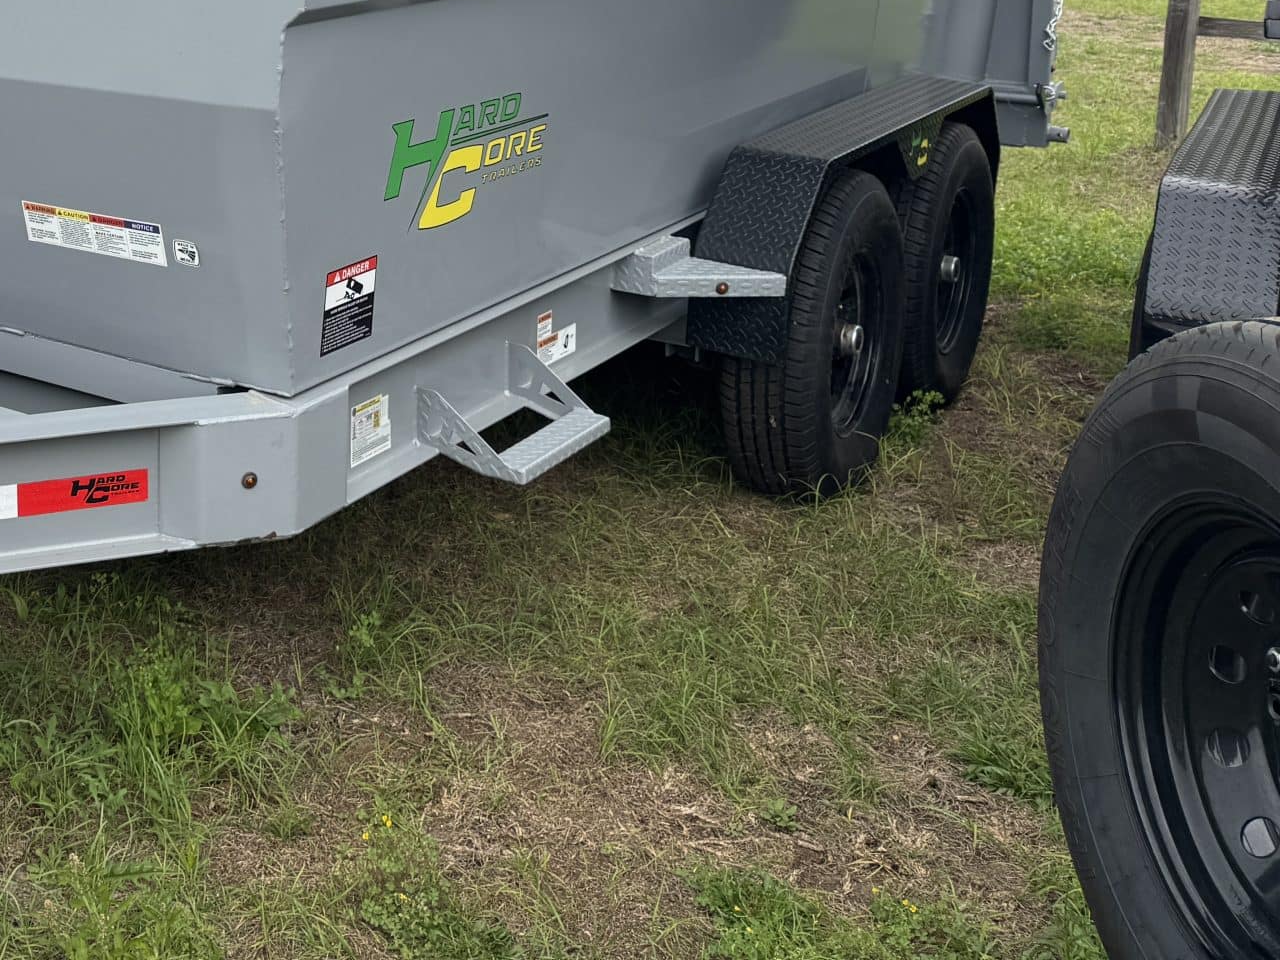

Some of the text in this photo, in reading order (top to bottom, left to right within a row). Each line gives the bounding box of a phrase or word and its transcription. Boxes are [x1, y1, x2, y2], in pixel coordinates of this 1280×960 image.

[384, 92, 522, 225] HARD
[481, 156, 543, 184] TRAILERS
[418, 123, 548, 230] CORE
[131, 223, 154, 232] NOTICE
[342, 261, 370, 280] DANGER
[70, 474, 126, 501] HARD
[85, 482, 140, 504] CORE
